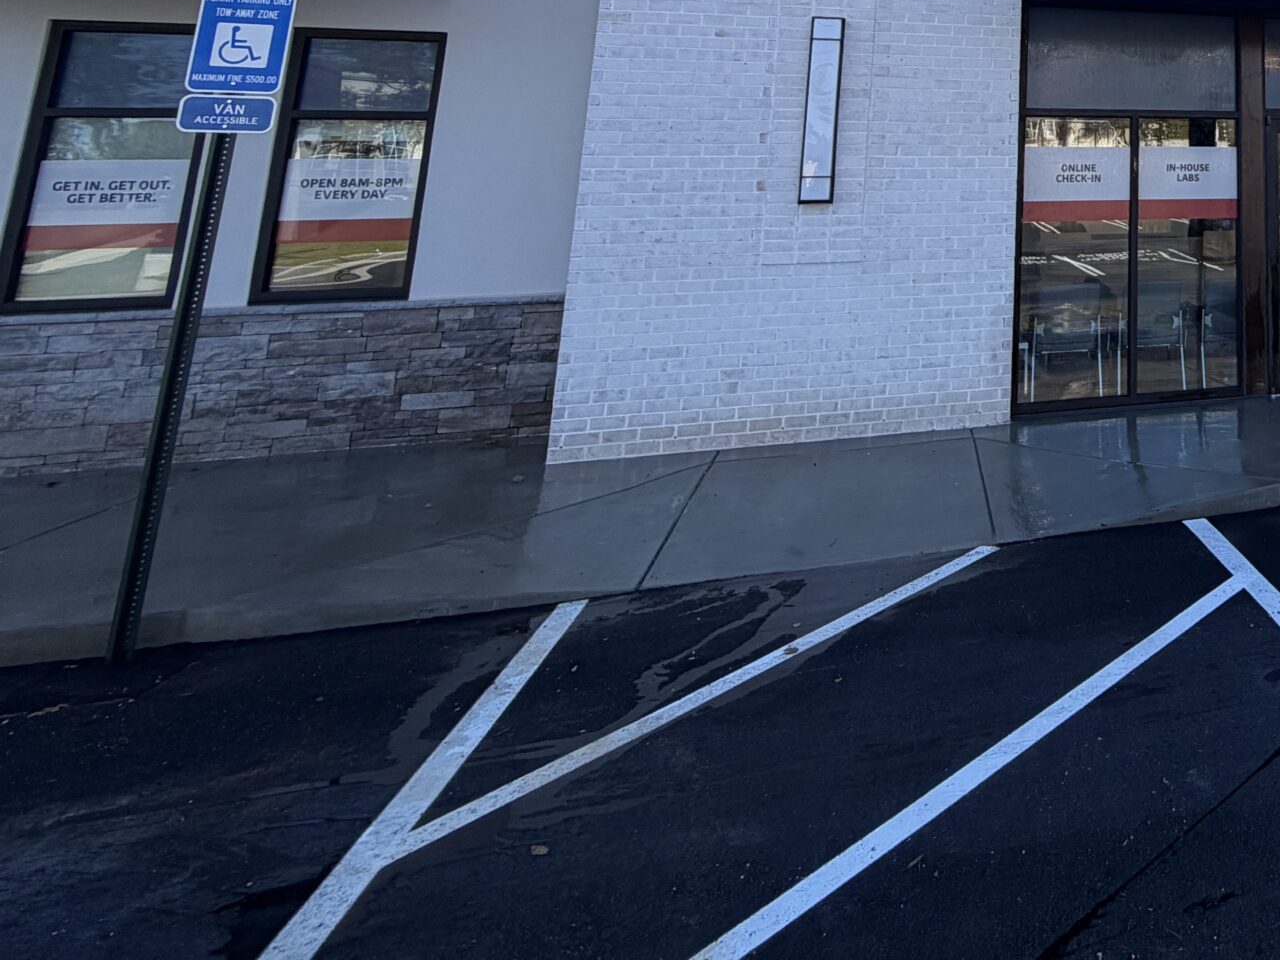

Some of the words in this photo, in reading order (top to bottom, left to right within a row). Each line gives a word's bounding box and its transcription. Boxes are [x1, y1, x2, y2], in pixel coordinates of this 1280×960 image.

[216, 7, 256, 18] TOW-AWAY
[257, 9, 280, 19] ZONE
[191, 73, 225, 82] MAXIMUM
[227, 74, 243, 83] FINE
[214, 103, 246, 115] VAN
[194, 115, 259, 125] ACCESSIBLE
[1061, 163, 1096, 172] ONLINE
[1166, 163, 1210, 172] IN-HOUSE
[300, 178, 337, 188] OPEN
[340, 177, 404, 188] 8AM-8PM
[1055, 174, 1101, 183] CHECK-IN
[1176, 173, 1200, 182] LABS
[52, 181, 81, 191] GET
[84, 181, 105, 191] IN.
[108, 180, 137, 191] GET
[138, 180, 171, 190] OUT.
[67, 193, 96, 204] GET
[314, 189, 358, 200] EVERY
[361, 189, 389, 199] DAY
